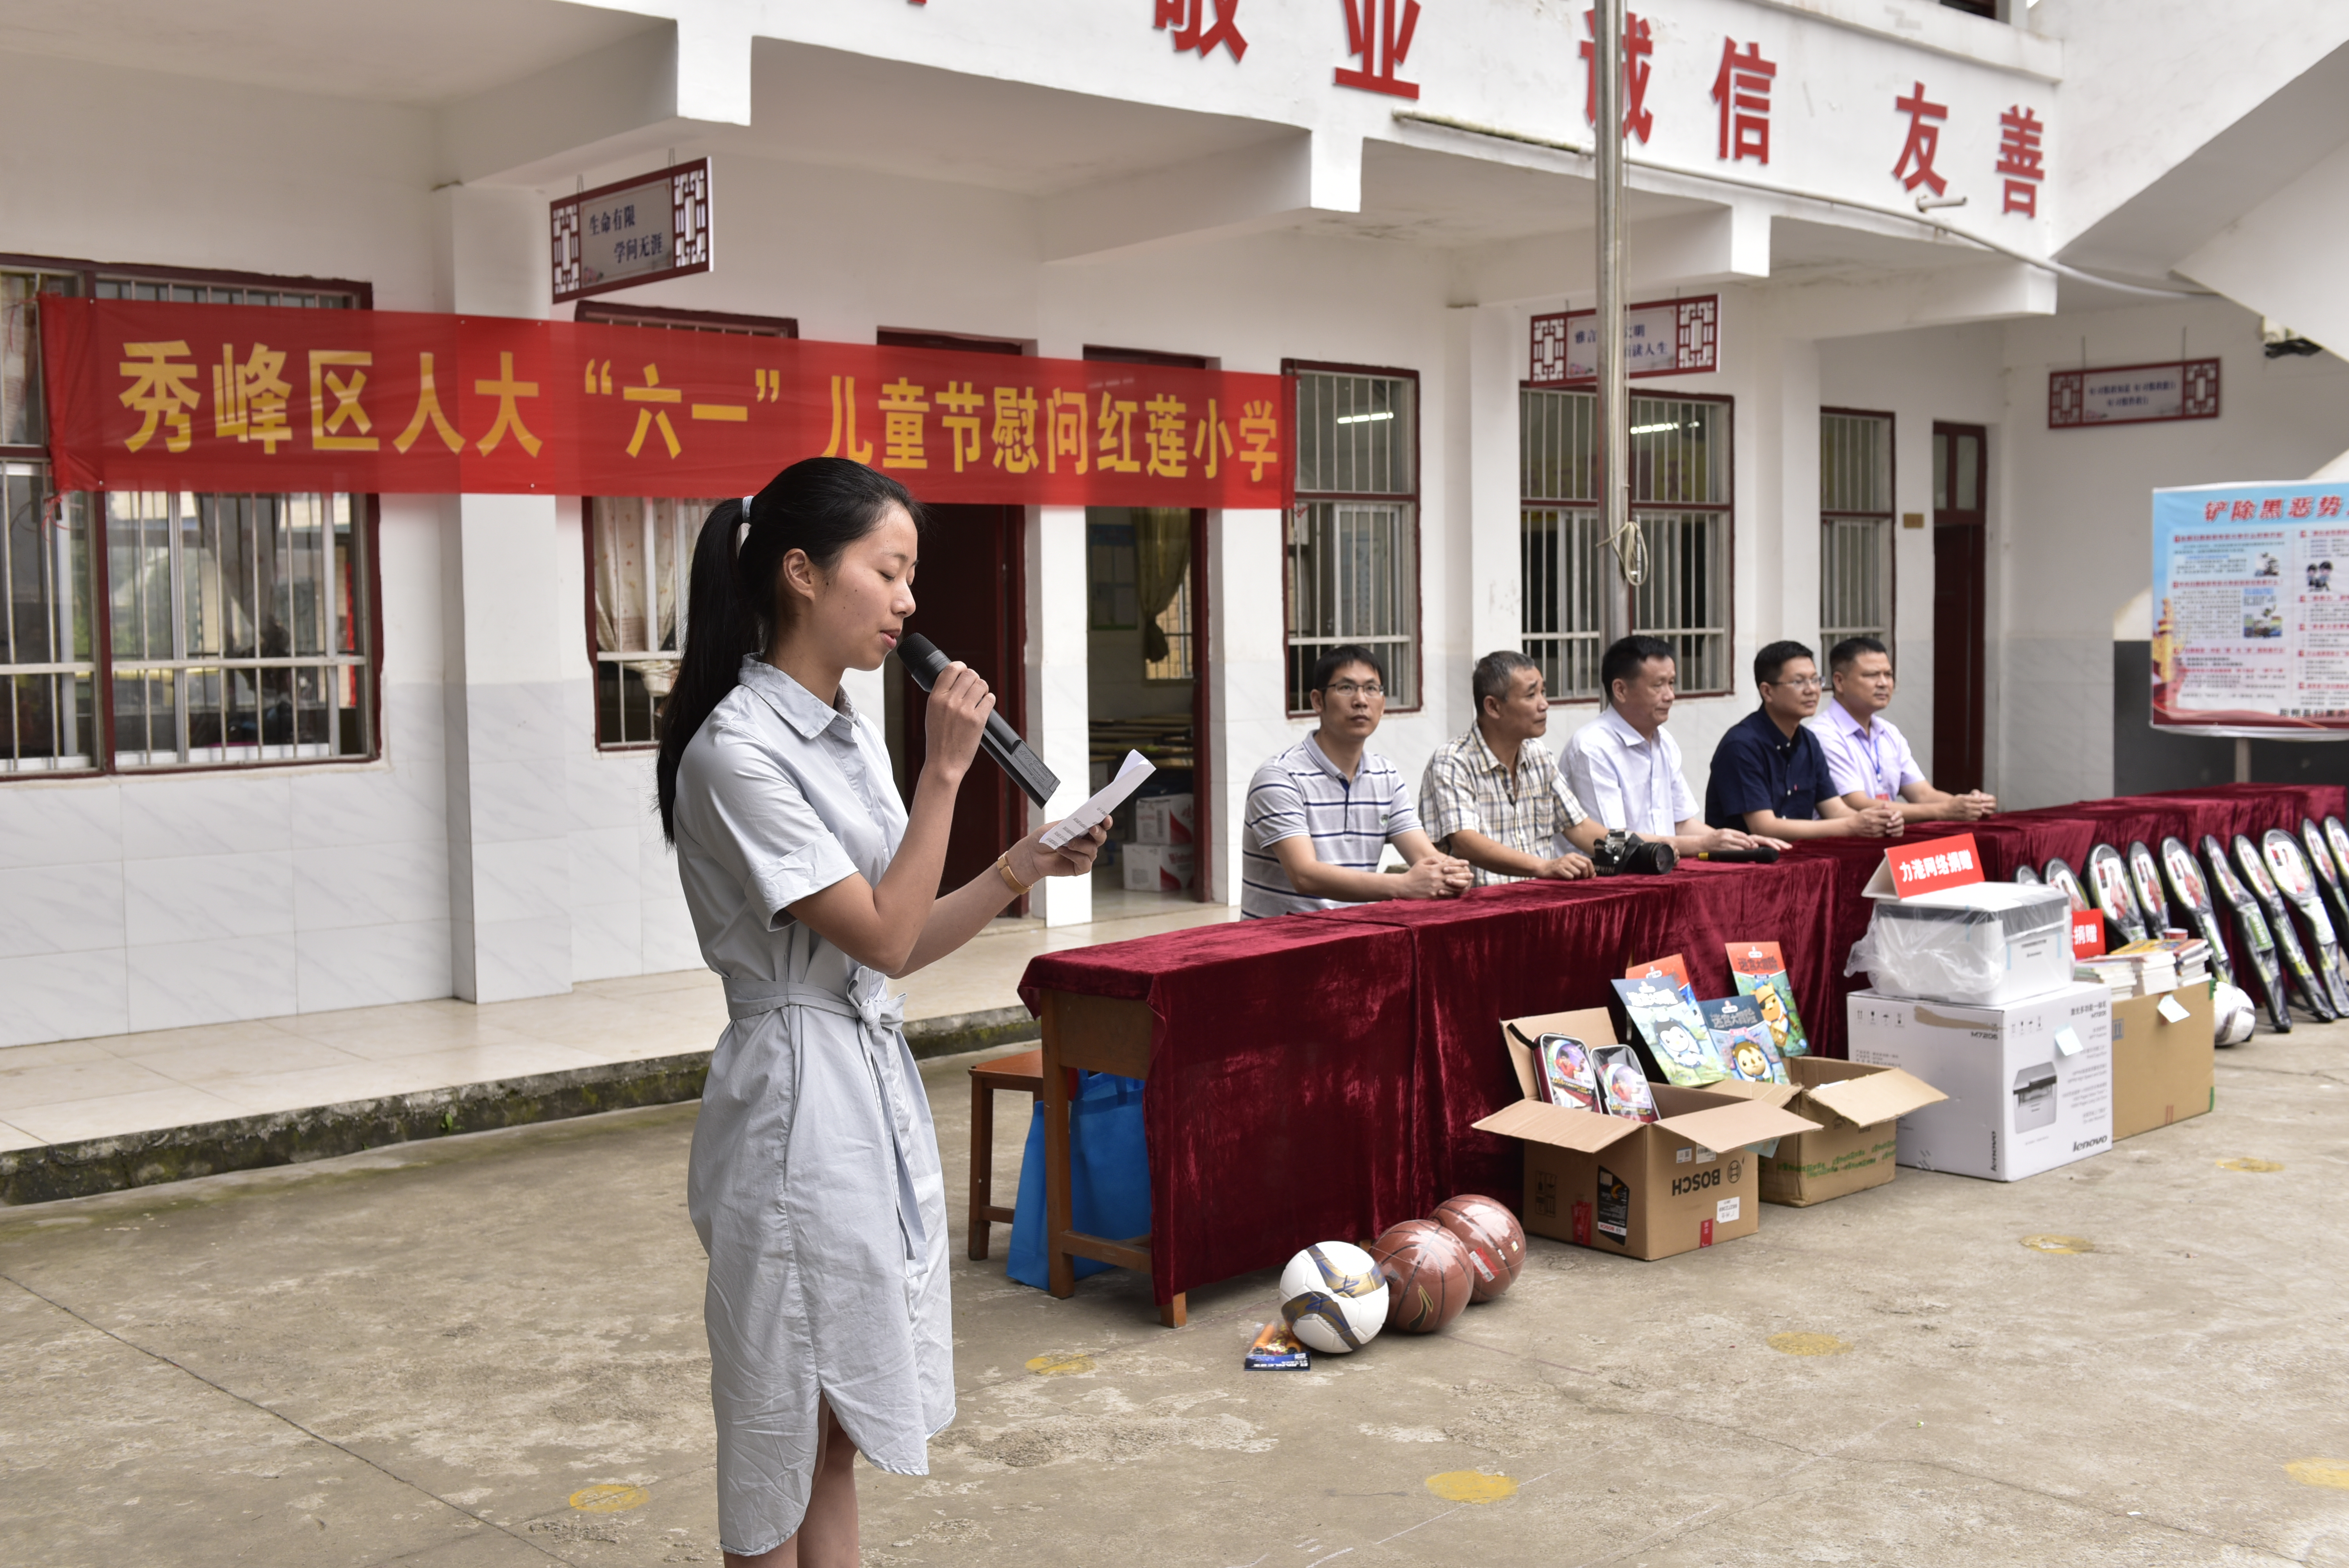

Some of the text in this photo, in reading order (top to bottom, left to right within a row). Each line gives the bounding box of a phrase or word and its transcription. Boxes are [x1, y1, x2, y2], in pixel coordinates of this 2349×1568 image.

[1891, 80, 2045, 219] 友善
[589, 204, 636, 236] 生命有限
[613, 232, 663, 264] 学问无涯
[2203, 495, 2349, 522] 铲除黑恶势
[1595, 864, 1615, 874] Niko
[1899, 849, 1974, 883] 力港网络捐赠
[2073, 1135, 2108, 1152] lenovo
[1672, 1168, 1721, 1196] BOSCH
